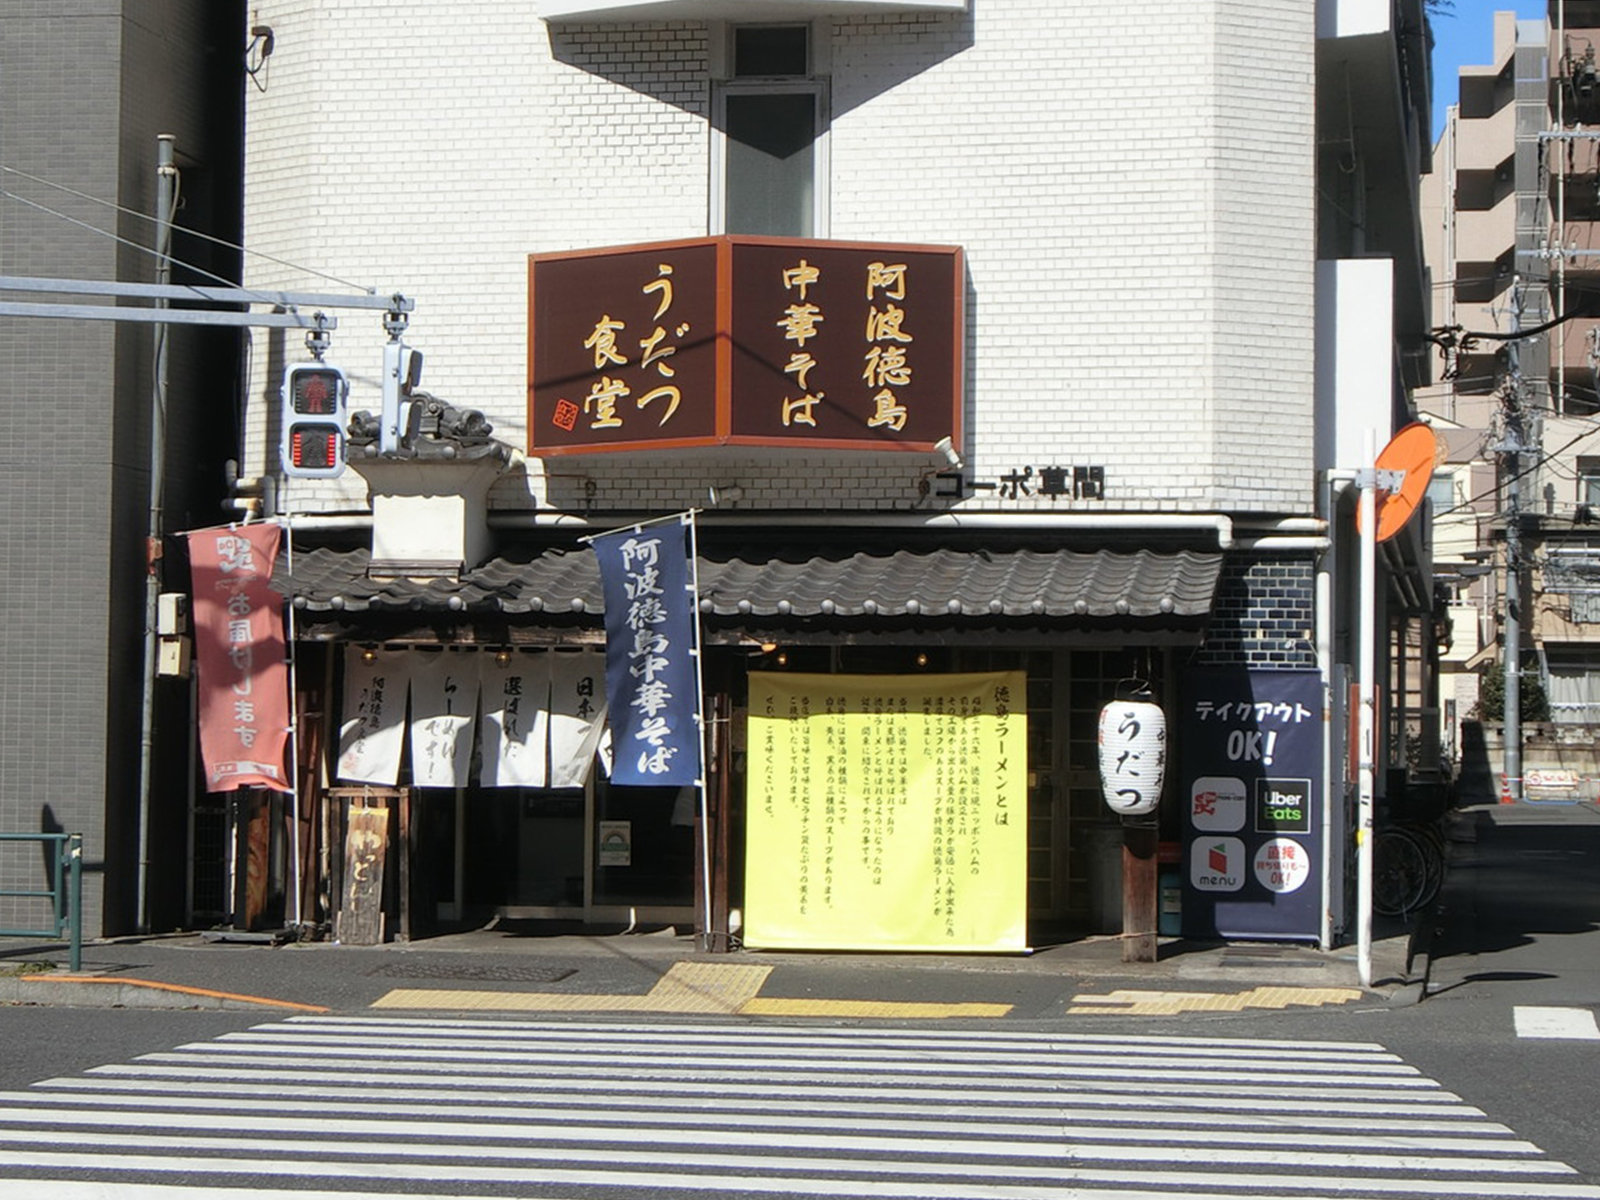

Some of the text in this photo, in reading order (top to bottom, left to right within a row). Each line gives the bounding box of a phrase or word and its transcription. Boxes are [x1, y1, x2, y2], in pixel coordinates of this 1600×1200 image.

[583, 314, 630, 430] 食堂
[636, 263, 690, 427] うだつ
[776, 259, 825, 428] 中華そば
[863, 261, 913, 432] 阿波徳島
[619, 538, 678, 774] 阿波徳島中華そば
[369, 676, 386, 730] 阿波徳島
[441, 676, 458, 760] らーめん
[1195, 701, 1312, 723] テイクアウト
[993, 685, 1011, 826] 徳島ラーメンとは
[1115, 711, 1146, 808] うだつ
[1226, 729, 1278, 767] OK!
[1264, 791, 1303, 806] Uber
[1264, 806, 1302, 820] Eats
[1199, 876, 1238, 887] menu
[1267, 845, 1296, 860] 直接
